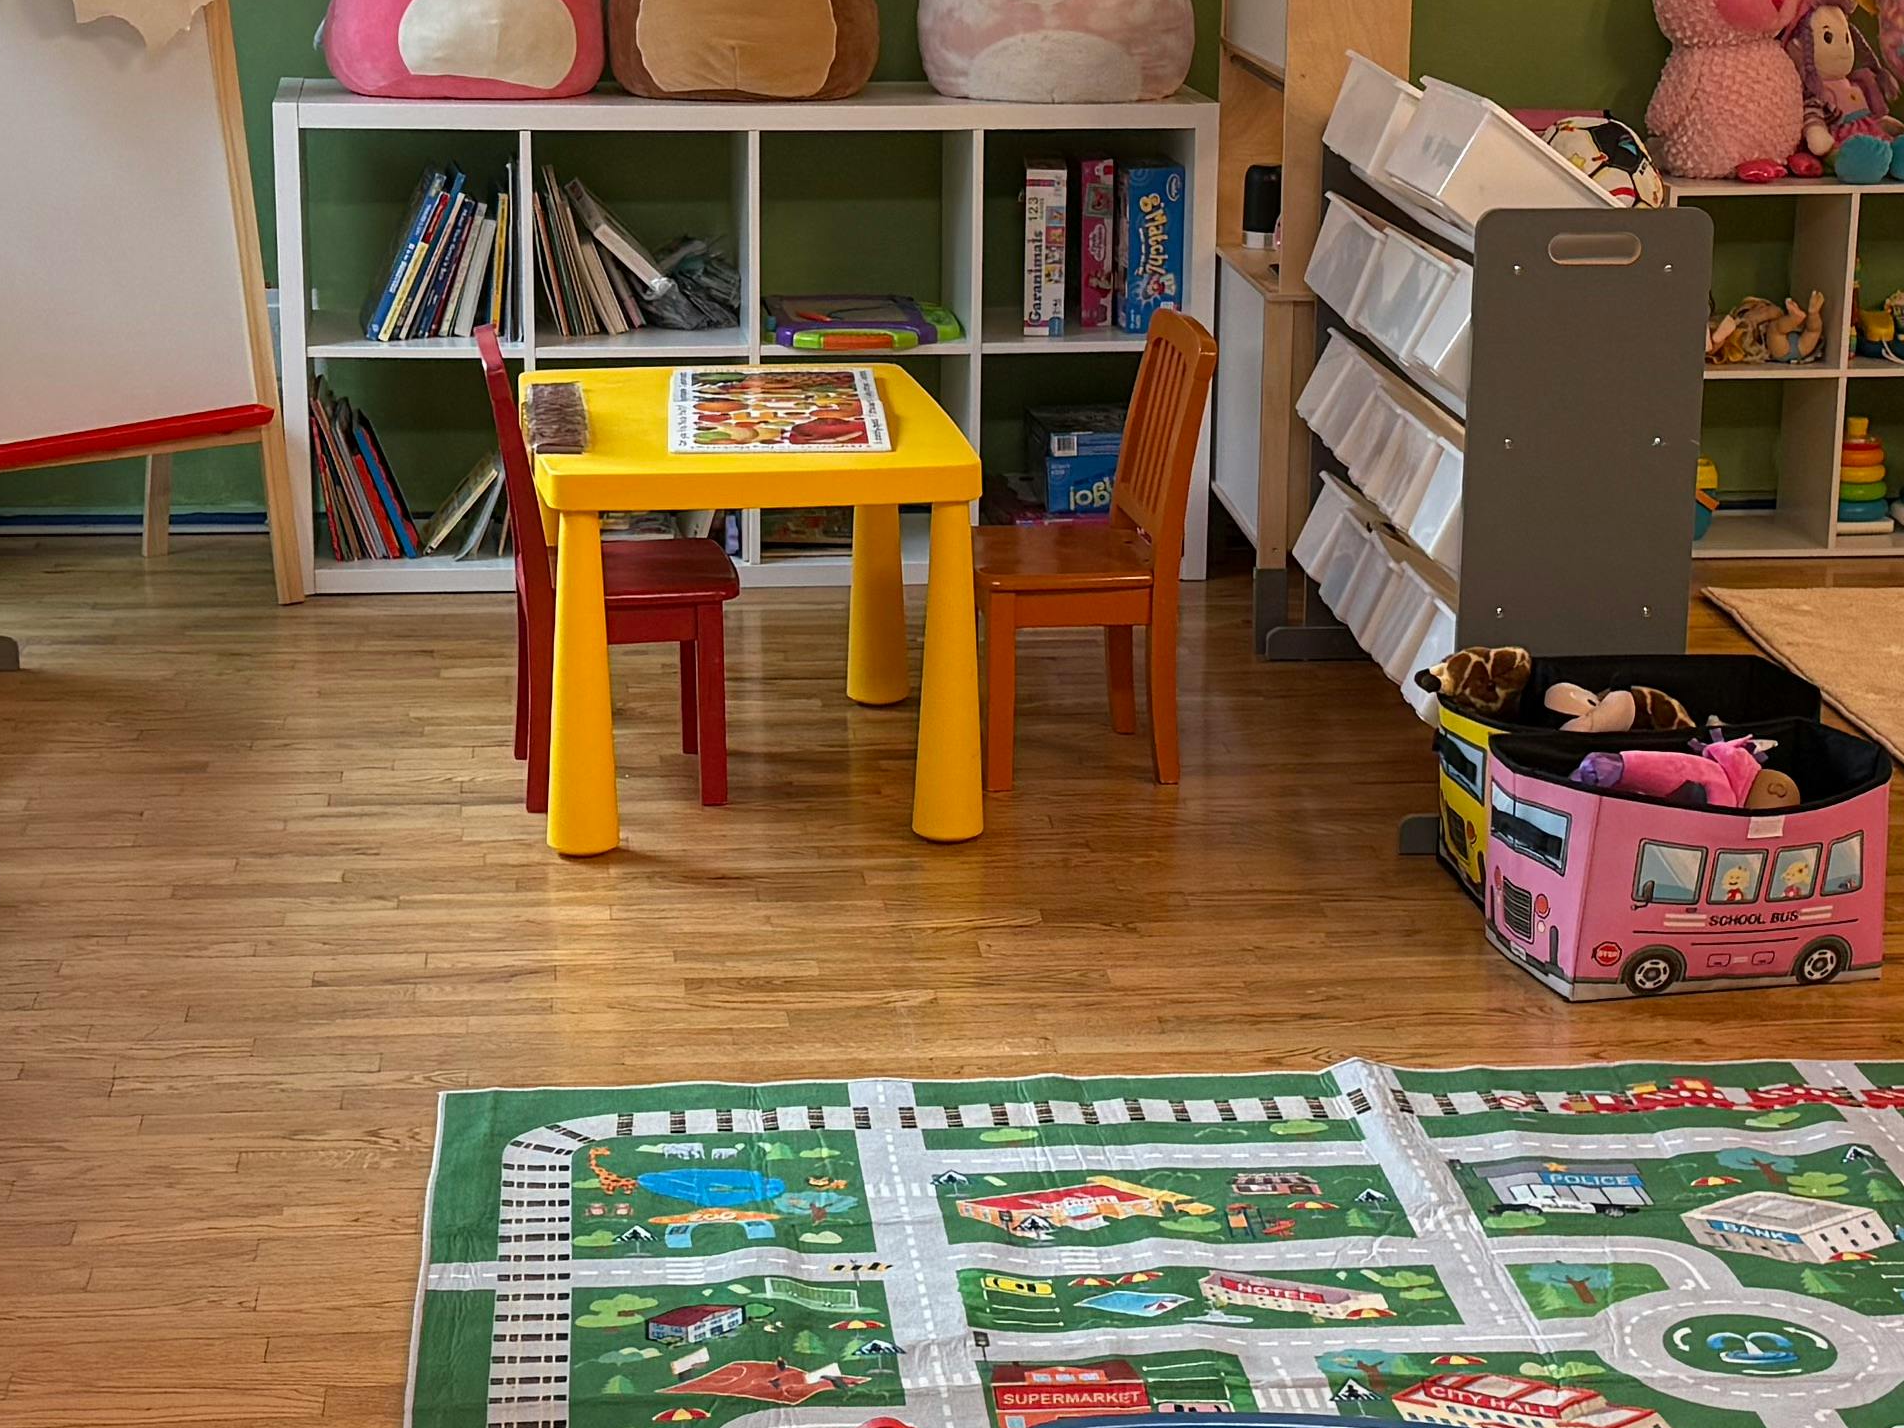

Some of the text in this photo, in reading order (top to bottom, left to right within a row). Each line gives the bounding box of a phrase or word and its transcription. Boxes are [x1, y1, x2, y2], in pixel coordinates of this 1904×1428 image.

[1027, 229, 1044, 324] Garanimals
[1708, 911, 1800, 927] SCHOOL BUS
[1549, 1173, 1631, 1187] POLICE
[689, 1211, 739, 1222] ZOO
[1723, 1221, 1789, 1242] BANK
[1236, 1281, 1310, 1301] HOTEL
[1002, 1389, 1141, 1409] SUPERMARKET
[1429, 1386, 1558, 1420] CITY HALL
